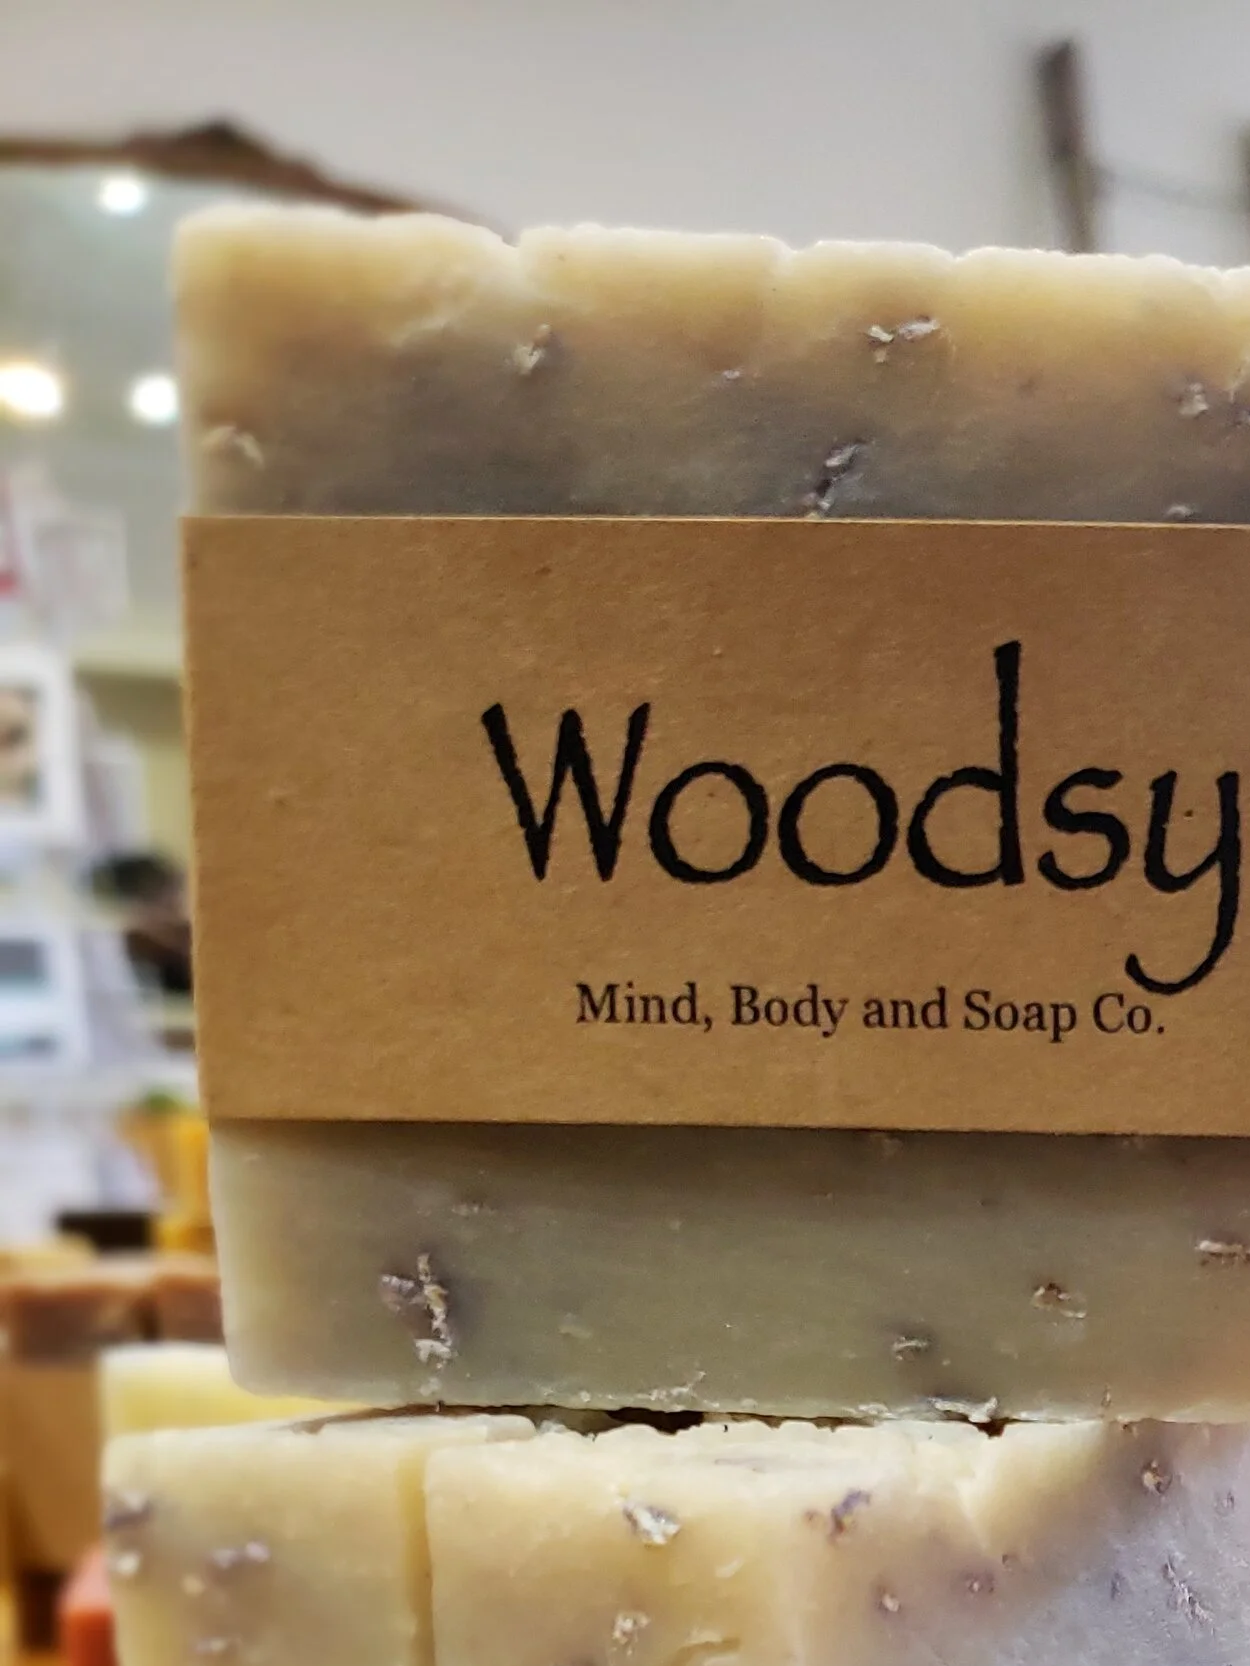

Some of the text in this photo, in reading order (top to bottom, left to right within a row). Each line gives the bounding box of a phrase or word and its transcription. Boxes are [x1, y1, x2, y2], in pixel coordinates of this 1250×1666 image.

[481, 640, 1242, 997] Woodsy
[575, 980, 1166, 1044] Mind, Body and Soap Co.
